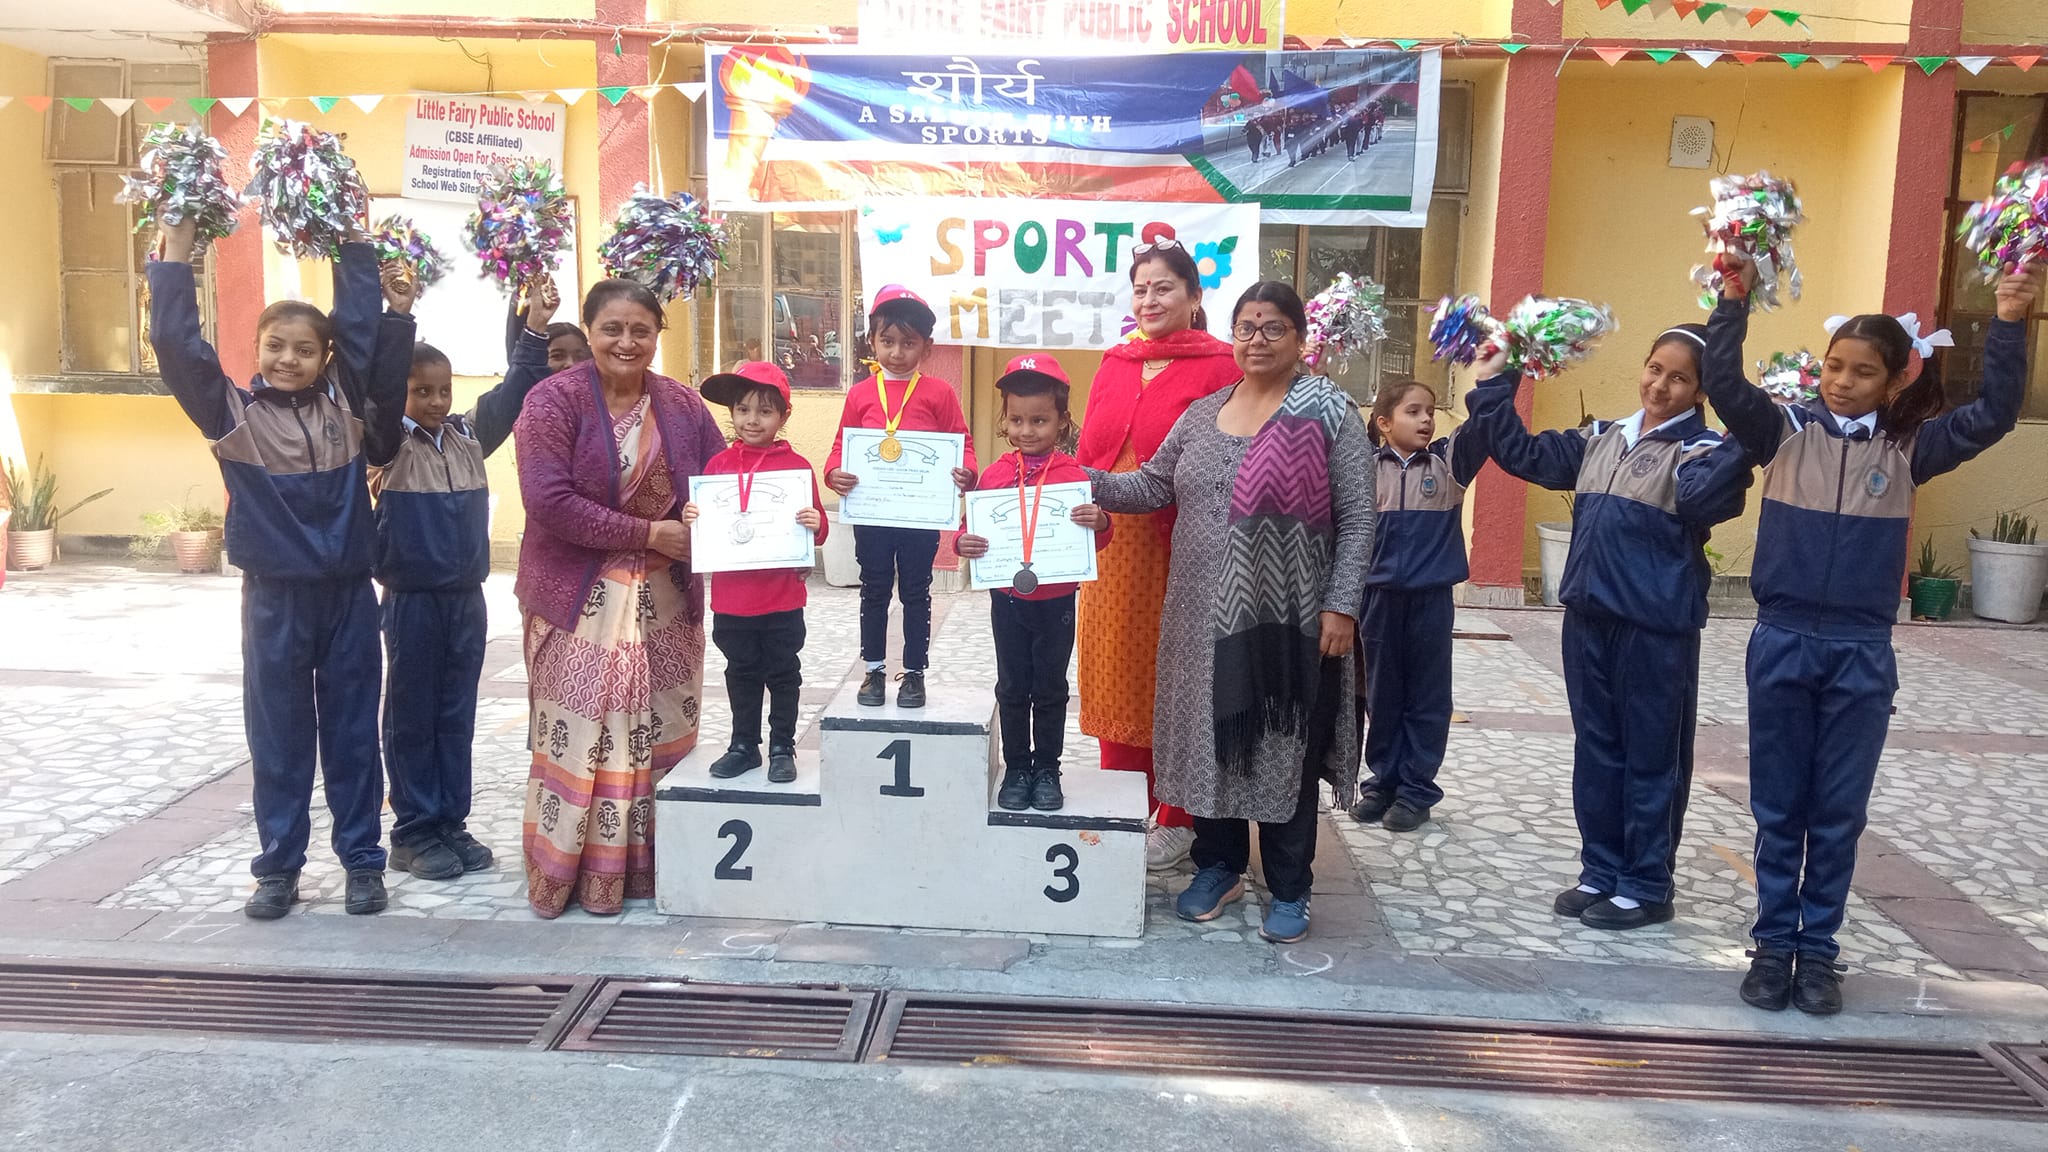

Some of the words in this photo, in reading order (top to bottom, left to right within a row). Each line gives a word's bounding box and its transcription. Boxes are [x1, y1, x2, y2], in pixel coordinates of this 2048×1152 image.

[1064, 0, 1152, 43] PUBLIC
[1166, 0, 1267, 44] SCHOOL
[900, 56, 1045, 105] शौर्य
[416, 98, 446, 121] Little
[448, 101, 477, 129] Fairy
[479, 104, 514, 128] Public
[517, 107, 555, 132] School
[858, 105, 877, 123] A
[889, 104, 1015, 130] SAL
[445, 130, 474, 145] (CBSE
[476, 133, 523, 152] Affiliated)
[921, 126, 1049, 144] SPORTS
[409, 144, 451, 161] Admission
[453, 148, 474, 166] Open
[476, 150, 489, 165] For
[422, 164, 472, 179] Registration
[410, 177, 439, 190] School
[440, 180, 458, 192] Web
[949, 287, 1116, 346] MEET
[876, 739, 925, 797] 1
[714, 818, 753, 881] 2
[1043, 843, 1080, 903] 3
